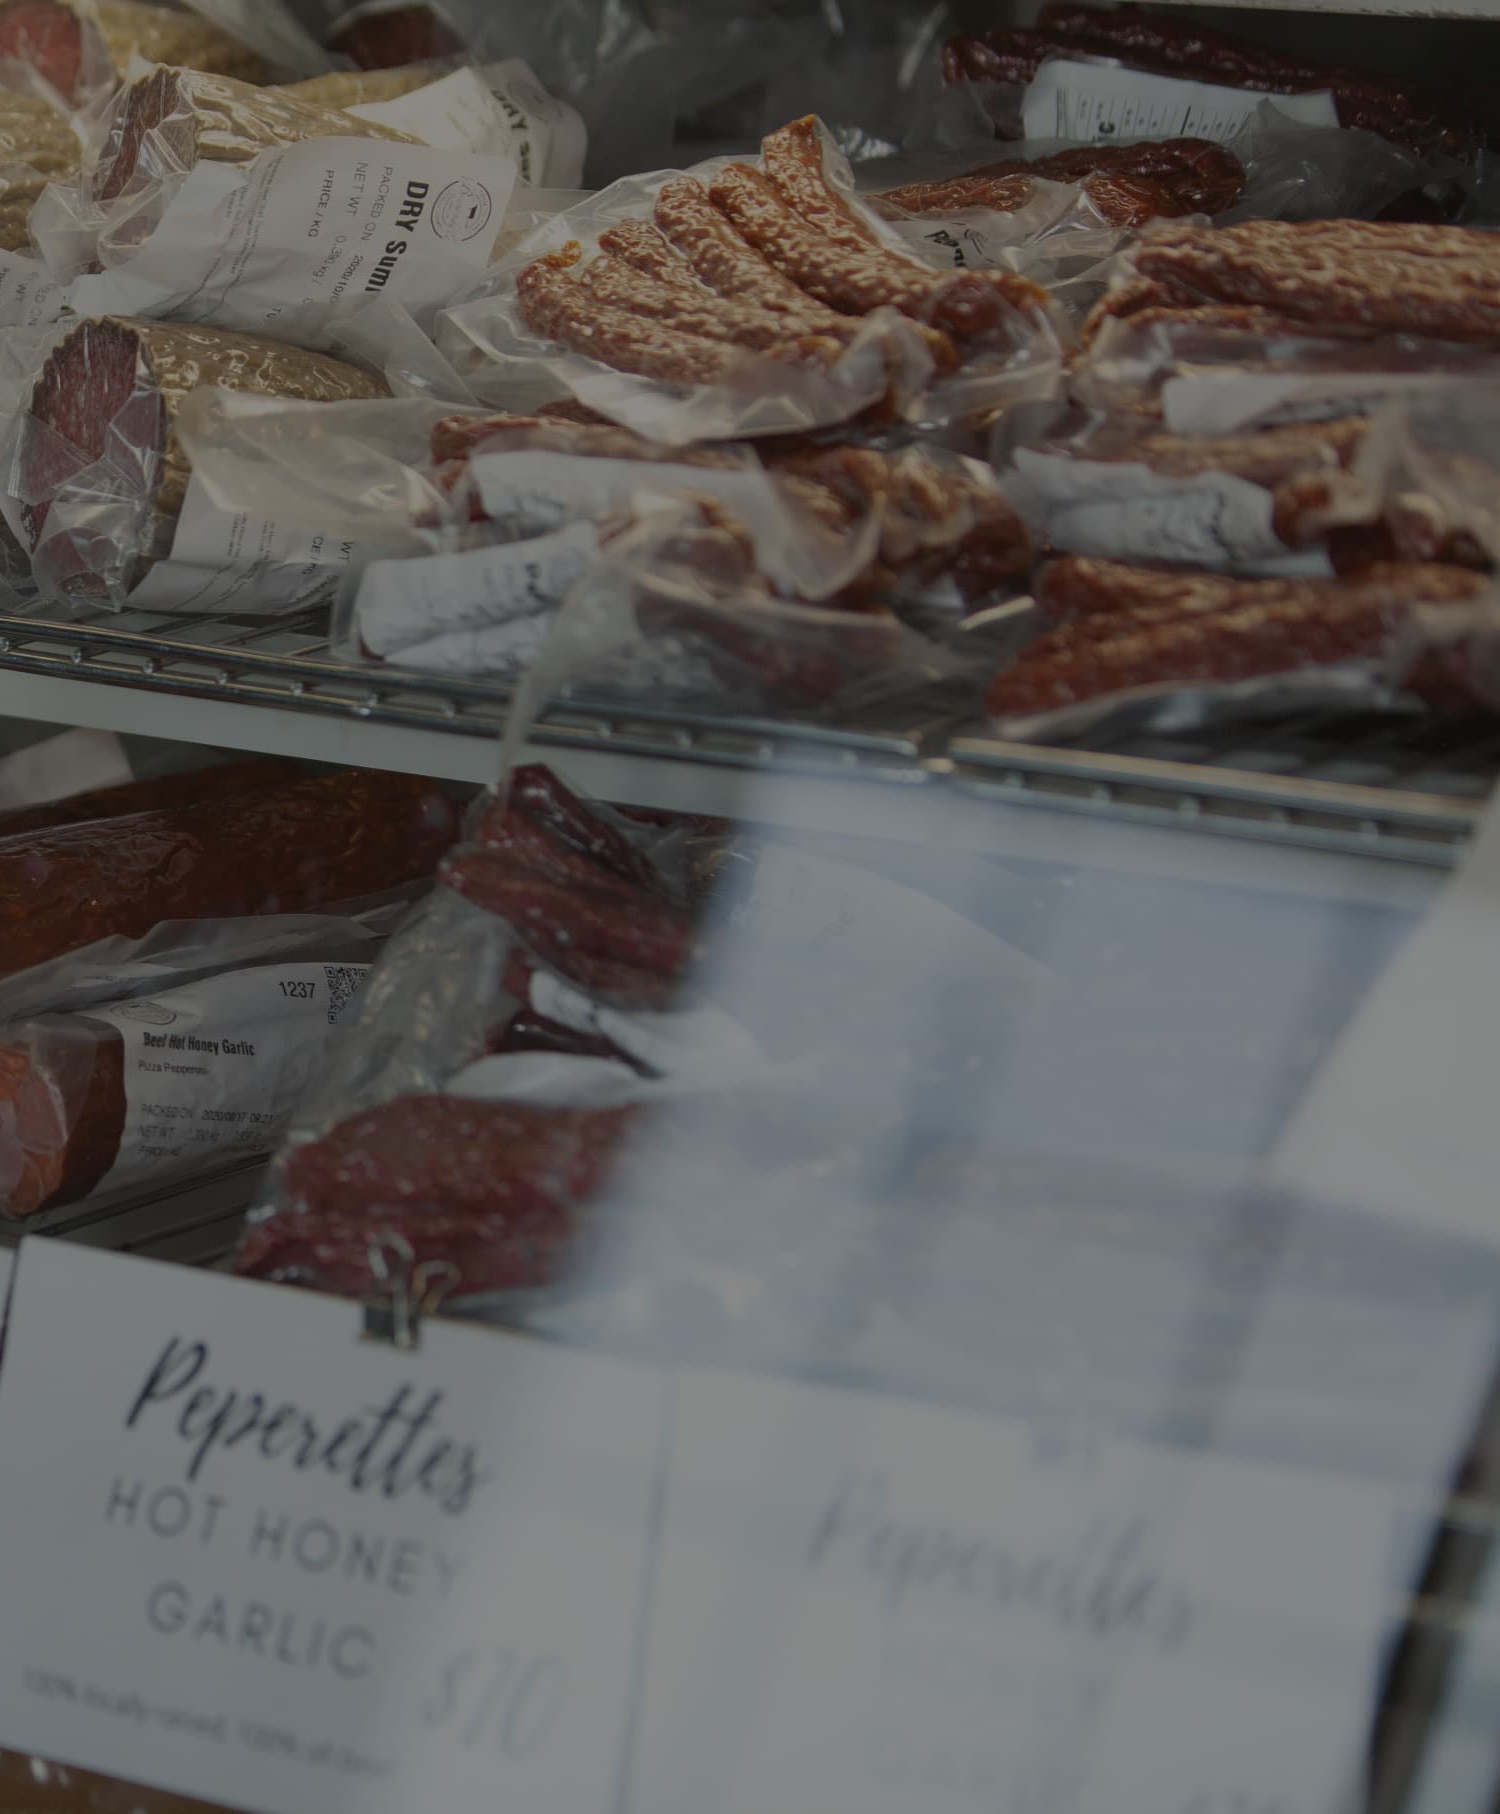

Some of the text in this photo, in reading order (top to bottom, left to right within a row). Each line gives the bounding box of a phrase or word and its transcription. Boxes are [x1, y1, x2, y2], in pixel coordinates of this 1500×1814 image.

[316, 168, 336, 210] PRICE
[351, 161, 370, 193] NET
[368, 165, 395, 218] PACKED
[344, 195, 360, 217] WT
[394, 180, 430, 232] DRY
[306, 219, 324, 239] KG
[278, 979, 316, 1000] 1237
[143, 1031, 255, 1057] Beef Hot Honey Garlic
[125, 1336, 484, 1512] Peperettes
[106, 1476, 462, 1594] HOT HONEY
[146, 1579, 378, 1681] GARLIC
